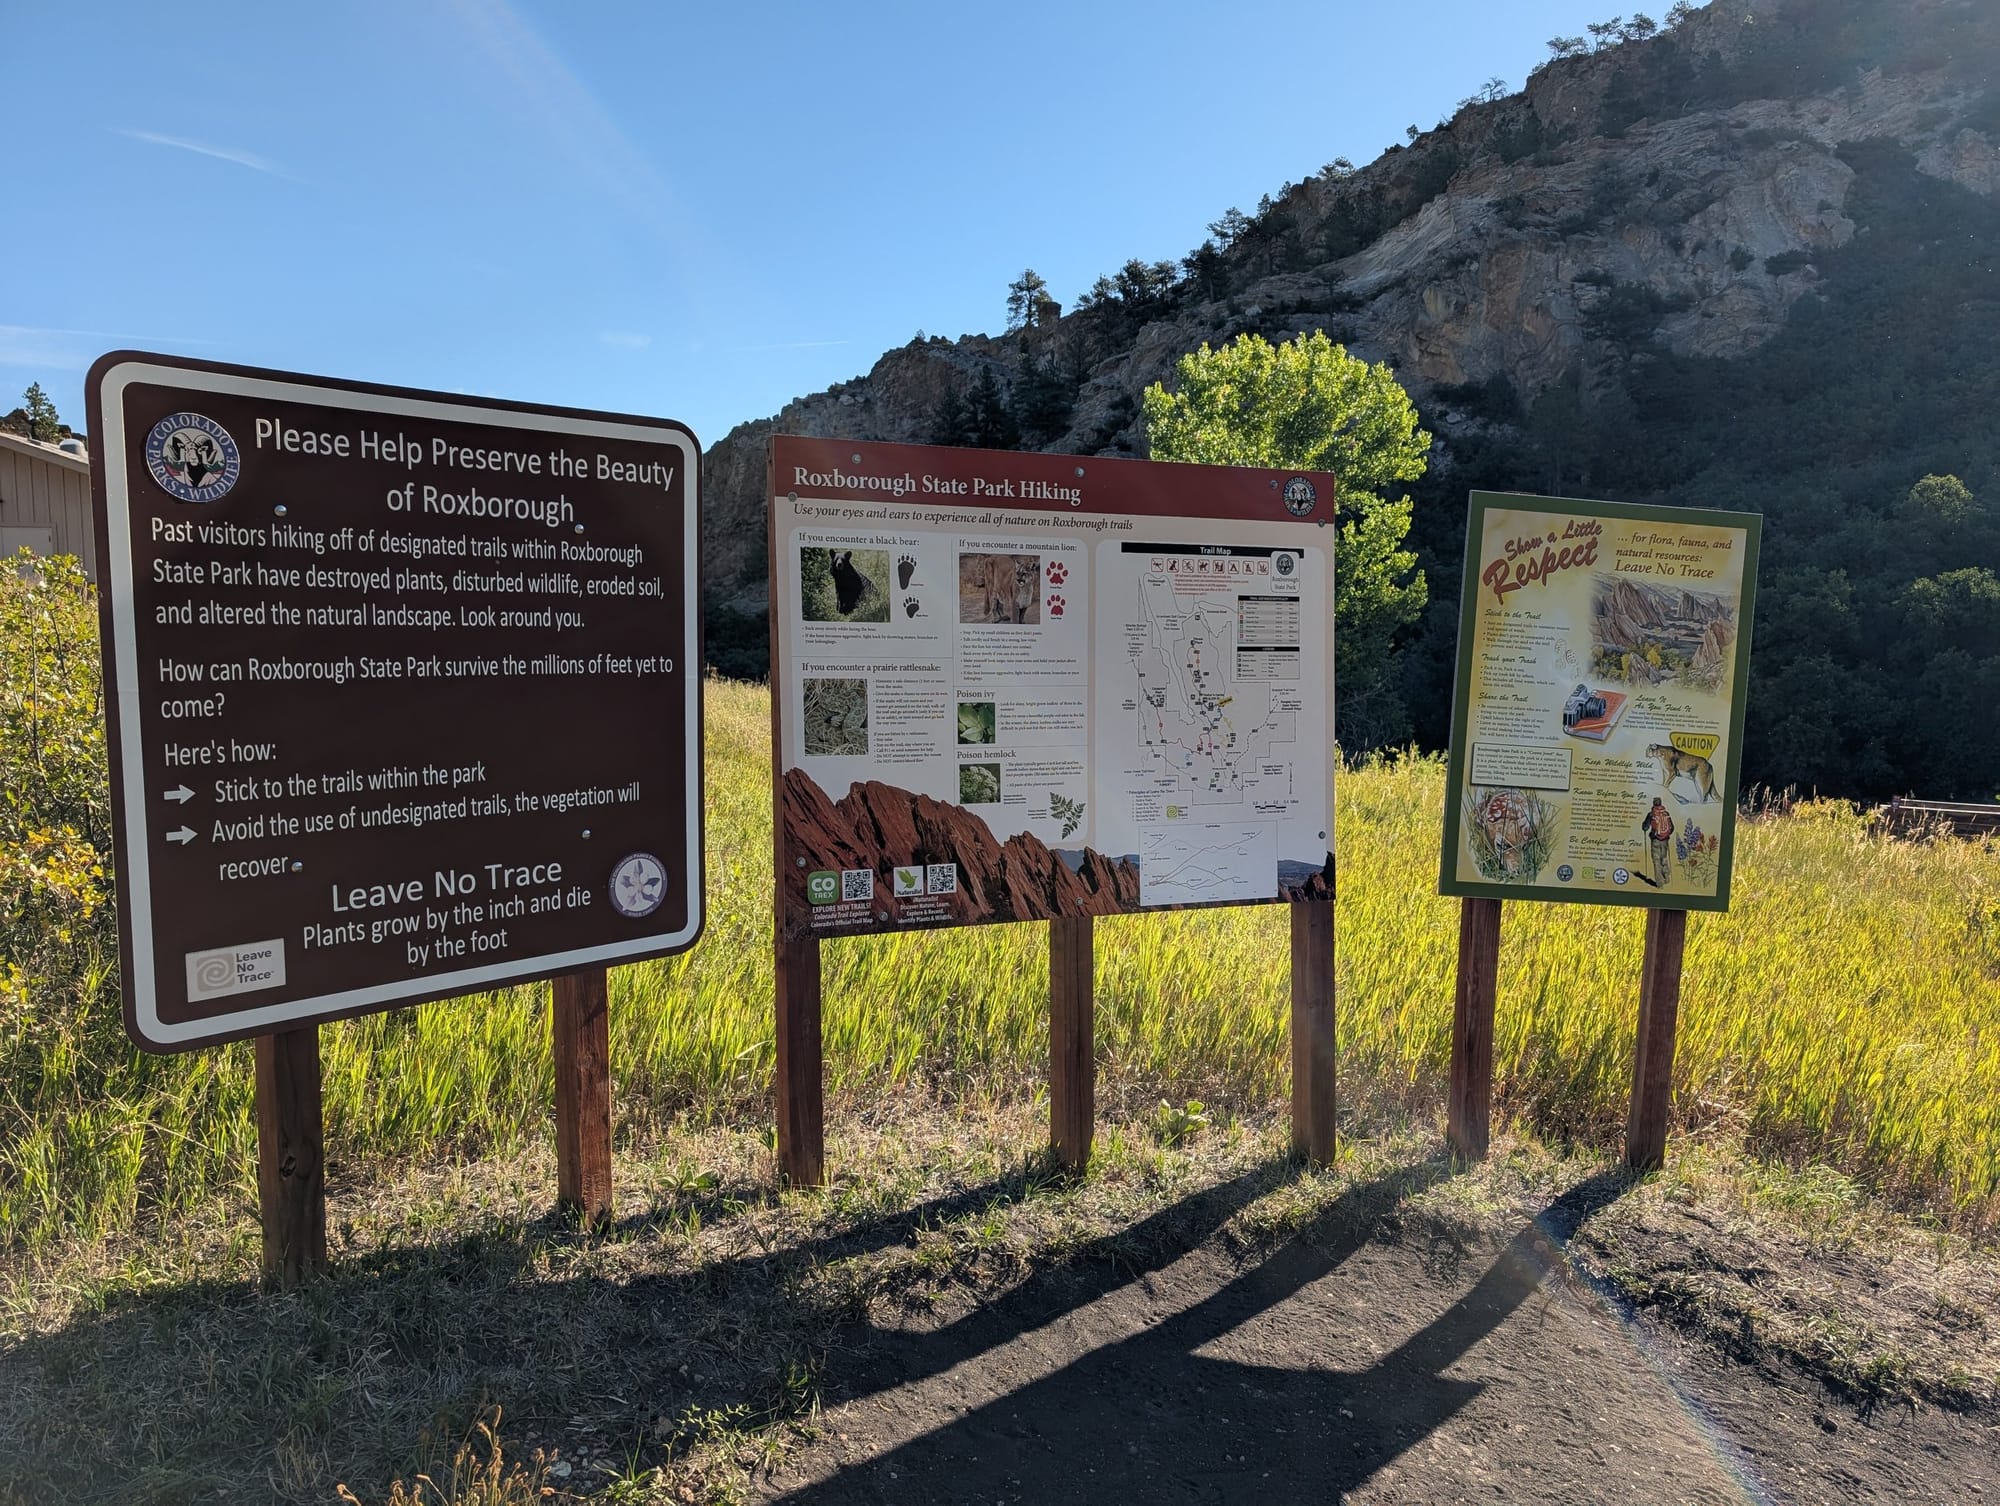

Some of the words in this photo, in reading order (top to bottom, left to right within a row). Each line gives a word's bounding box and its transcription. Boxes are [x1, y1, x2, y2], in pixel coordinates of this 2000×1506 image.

[154, 415, 231, 446] COLORADO
[255, 418, 350, 457] Please
[360, 430, 423, 470] Help
[432, 437, 542, 475] Preserve
[548, 448, 588, 478] the
[596, 454, 674, 492] Beauty
[149, 449, 178, 491] PARKS
[188, 456, 237, 499] WILDLIFE
[794, 467, 916, 495] Roxborough
[922, 475, 967, 495] State
[973, 478, 1014, 498] Park
[1020, 481, 1081, 506] Hiking
[386, 482, 415, 512] of
[423, 485, 574, 528] Roxborough
[793, 503, 814, 515] Use
[814, 506, 841, 519] your
[842, 509, 865, 520] eyes
[866, 507, 887, 519] and
[889, 511, 910, 520] ears
[912, 512, 922, 521] to
[924, 511, 977, 524] experience
[978, 512, 991, 524] all
[993, 512, 1003, 525] of
[1004, 514, 1036, 526] nature
[1037, 518, 1050, 527] on
[1052, 516, 1108, 531] Roxborough
[1110, 519, 1133, 530] trails
[151, 516, 194, 543] Past
[198, 520, 266, 547] visitors
[271, 523, 326, 555] hiking
[329, 527, 354, 551] off
[358, 528, 375, 552] of
[379, 530, 467, 559] designated
[470, 536, 508, 558] trails
[511, 538, 557, 560] within
[561, 540, 643, 568] Roxborough
[799, 532, 807, 541] If
[807, 534, 823, 543] you
[825, 535, 867, 544] encounter
[876, 536, 898, 545] black
[899, 537, 920, 546] bear:
[959, 539, 965, 547] If
[966, 541, 981, 550] you
[981, 541, 1018, 549] encounter
[1025, 543, 1060, 551] mountain
[1199, 546, 1215, 554] Trail
[1216, 546, 1232, 556] Map
[1505, 535, 1544, 562] Show
[1547, 530, 1558, 545] a
[1562, 519, 1603, 539] Little
[1631, 532, 1646, 544] for
[1648, 533, 1674, 546] flora,
[1678, 537, 1709, 549] fauna,
[1712, 538, 1733, 550] and
[1615, 549, 1652, 559] natural
[1655, 552, 1703, 563] resources:
[1615, 560, 1652, 575] Leave
[1655, 563, 1675, 576] No
[1680, 564, 1714, 579] Trace
[153, 558, 204, 584] State
[210, 560, 253, 585] Park
[257, 561, 301, 587] have
[305, 563, 391, 594] destroyed
[395, 567, 448, 595] plants,
[452, 569, 524, 593] disturbed
[527, 572, 583, 598] wildlife,
[586, 575, 635, 596] eroded
[638, 576, 664, 600] soil,
[1483, 537, 1600, 605] Respect
[156, 599, 193, 624] and
[199, 599, 266, 625] altered
[270, 601, 301, 625] the
[306, 602, 367, 626] natural
[372, 603, 456, 632] landscape.
[460, 605, 496, 627] Look
[500, 606, 551, 627] around
[555, 612, 585, 633] you.
[1484, 608, 1502, 617] Stick
[1524, 611, 1542, 620] Trail
[159, 658, 204, 682] How
[209, 663, 243, 681] can
[248, 655, 355, 684] Roxborough
[359, 656, 402, 679] State
[407, 655, 442, 678] Park
[445, 655, 499, 677] survive
[502, 654, 527, 676] the
[531, 653, 585, 675] millions
[588, 653, 603, 674] of
[605, 653, 633, 674] feet
[635, 655, 657, 678] yet
[659, 655, 673, 673] to
[802, 662, 810, 671] If
[809, 664, 825, 673] you
[826, 663, 865, 672] encounter
[872, 664, 898, 673] prairie
[899, 663, 942, 672] rattlesnake:
[161, 692, 225, 719] come?
[956, 690, 982, 698] Poison
[984, 690, 995, 700] ivy
[1635, 694, 1655, 702] Leave
[1657, 695, 1667, 703] It
[164, 739, 226, 767] Here's
[231, 738, 277, 763] how:
[957, 751, 982, 759] Poison
[984, 749, 1017, 758] hemlock
[1676, 737, 1713, 750] CAUTION
[215, 776, 259, 803] Stick
[263, 778, 283, 799] to
[287, 773, 317, 797] the
[321, 769, 364, 794] trails
[367, 766, 418, 791] within
[422, 763, 448, 786] the
[452, 760, 486, 789] park
[211, 814, 264, 843] Avoid
[269, 812, 299, 837] the
[304, 814, 334, 833] use
[338, 805, 356, 830] of
[361, 796, 467, 828] undesignated
[470, 793, 511, 817] trails,
[514, 791, 539, 812] the
[542, 788, 614, 813] vegetation
[617, 781, 640, 803] will
[332, 880, 424, 912] Leave
[435, 869, 476, 898] No
[484, 862, 562, 890] Trace
[811, 877, 835, 891] CO
[814, 891, 833, 899] TREX
[303, 921, 366, 949] Plants
[371, 915, 421, 944] grow
[426, 907, 449, 933] by
[452, 901, 484, 925] the
[489, 894, 525, 920] inch
[530, 888, 561, 914] and
[566, 886, 591, 908] die
[812, 905, 836, 914] EXPLORE
[837, 904, 850, 912] NEW
[851, 902, 872, 910] TRAILS!
[236, 949, 272, 963] Leave
[407, 940, 430, 967] by
[434, 935, 466, 959] the
[470, 928, 508, 953] foot
[237, 963, 255, 973] No
[238, 971, 272, 984] Trace
